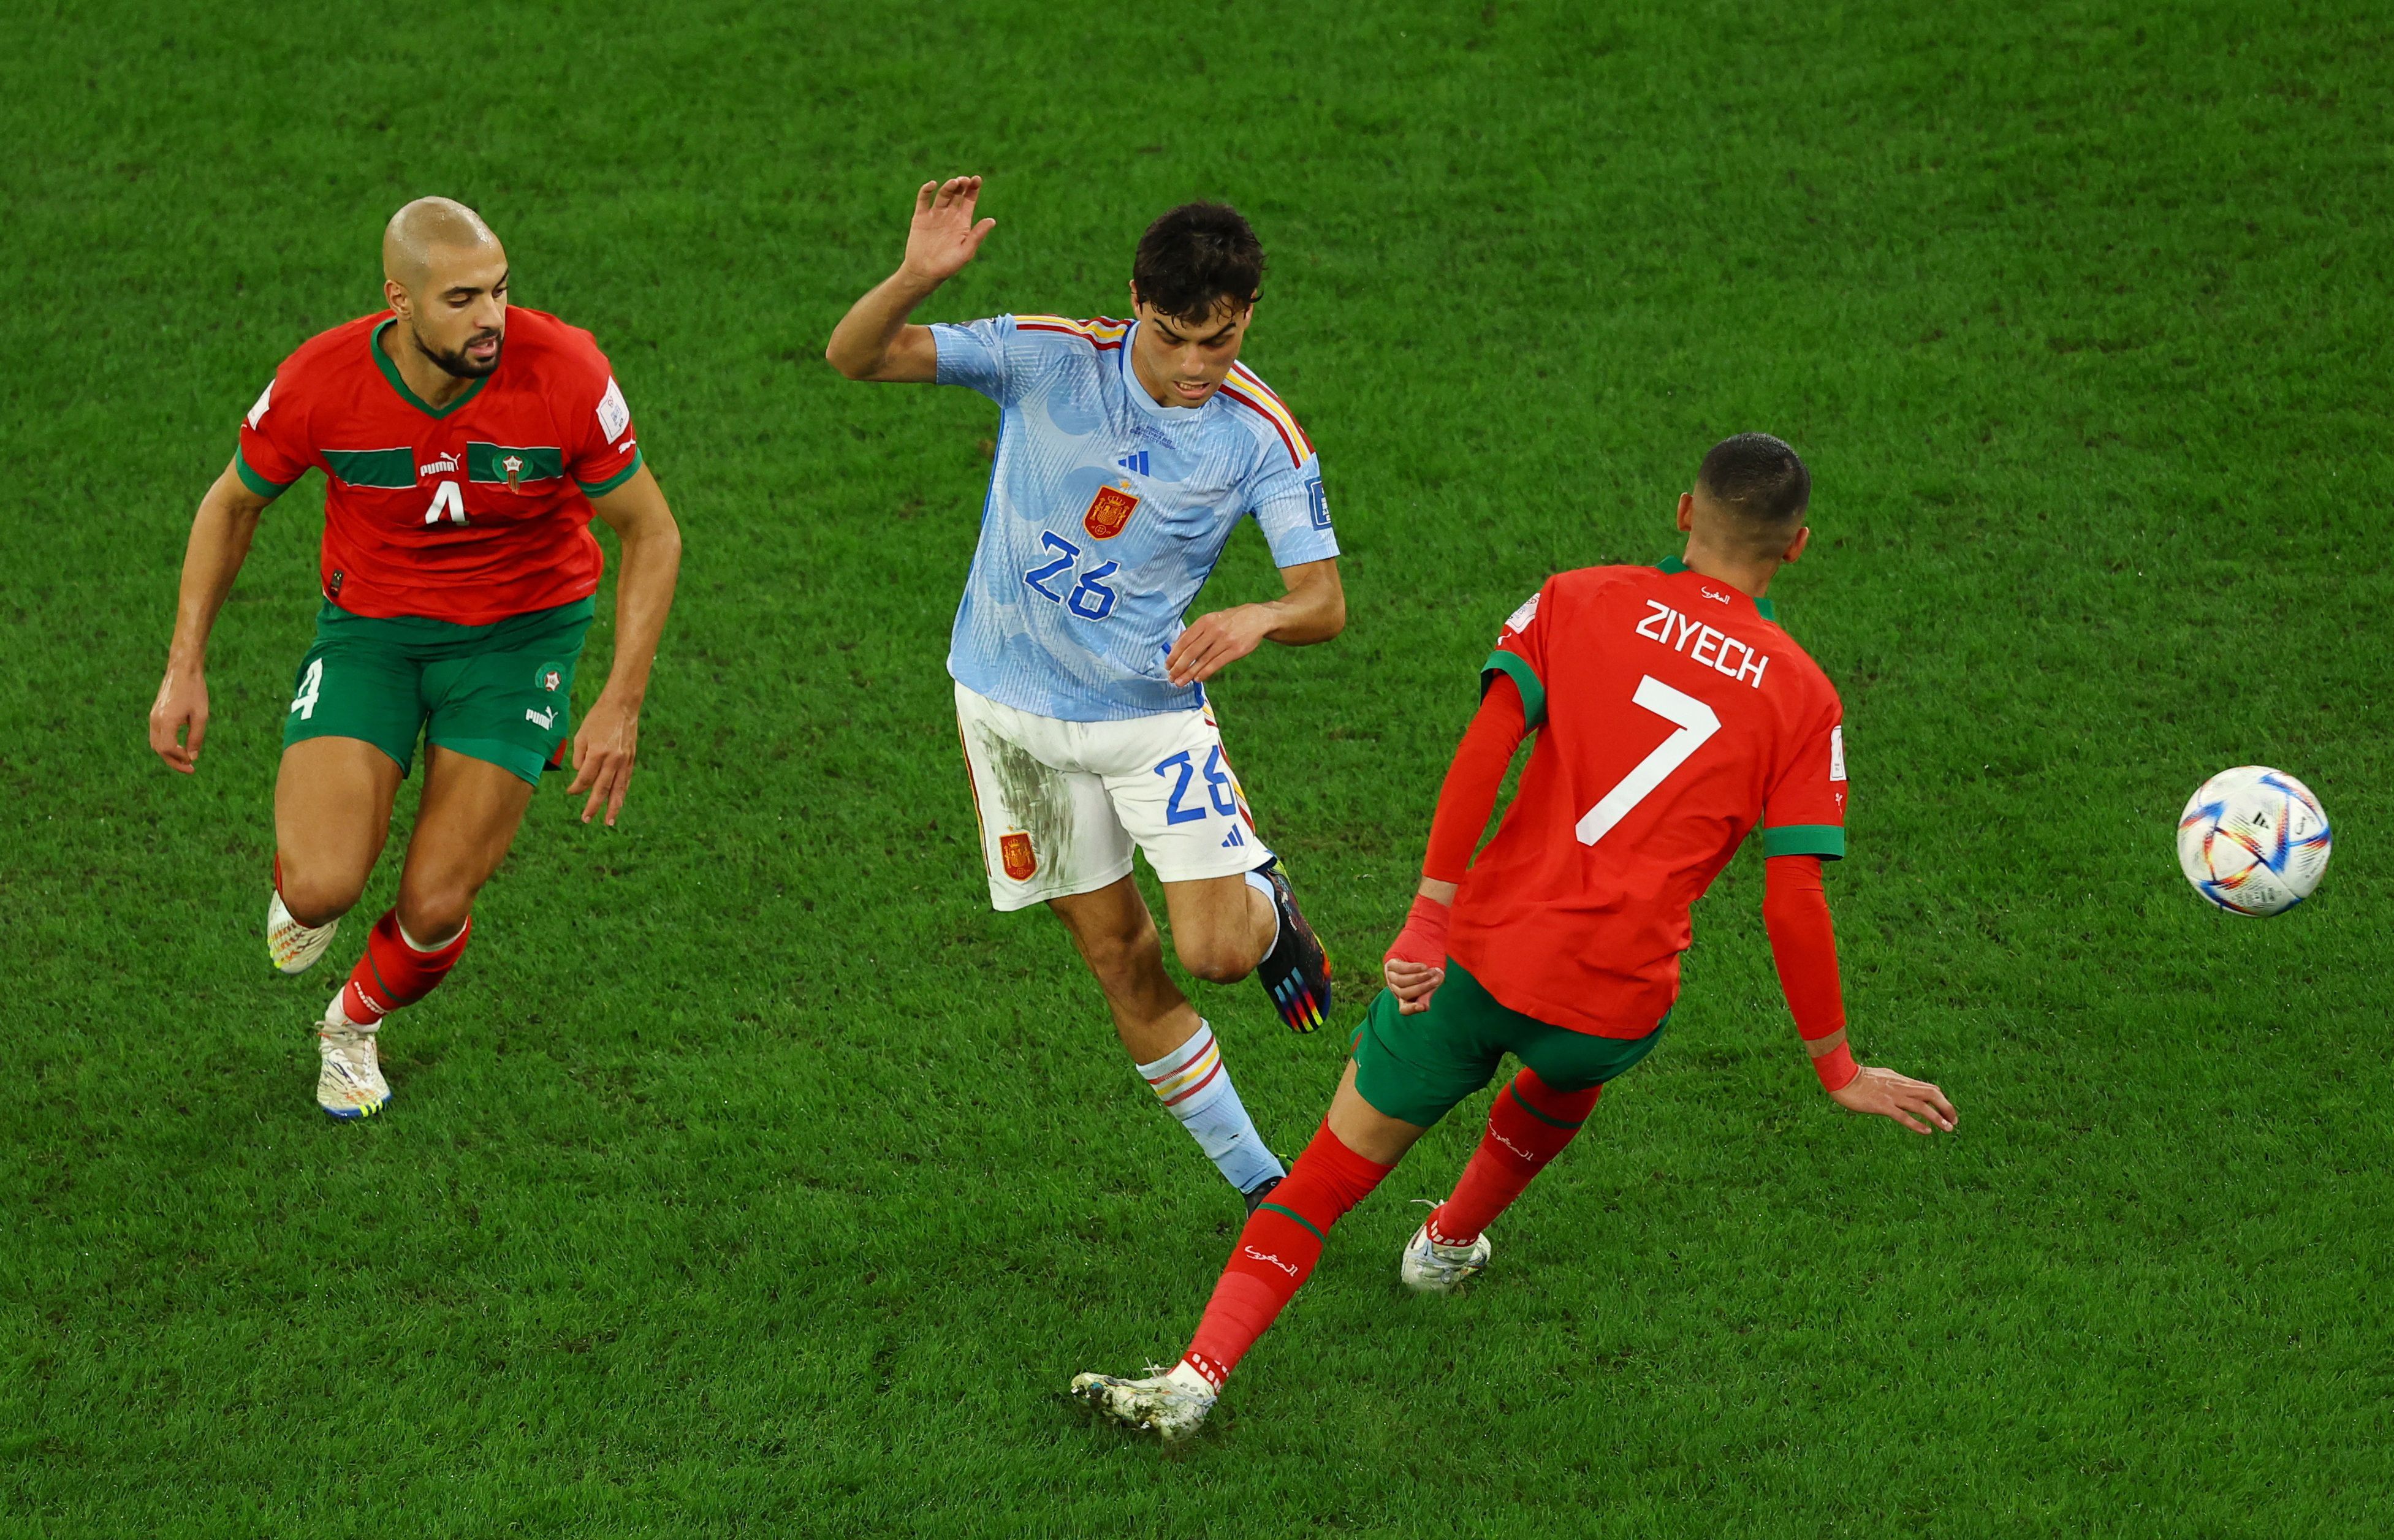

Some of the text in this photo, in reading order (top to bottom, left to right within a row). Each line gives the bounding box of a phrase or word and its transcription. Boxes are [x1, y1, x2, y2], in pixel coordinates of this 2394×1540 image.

[420, 461, 455, 477] PUMA
[1023, 529, 1120, 622] 26
[1701, 586, 1730, 605] المغرب
[1635, 599, 1769, 689] ZIYECH
[291, 658, 323, 720] 4
[526, 708, 550, 730] PUMA
[1153, 745, 1236, 825] 26
[1575, 674, 1722, 846] 7
[1245, 1245, 1298, 1277] المغرب
